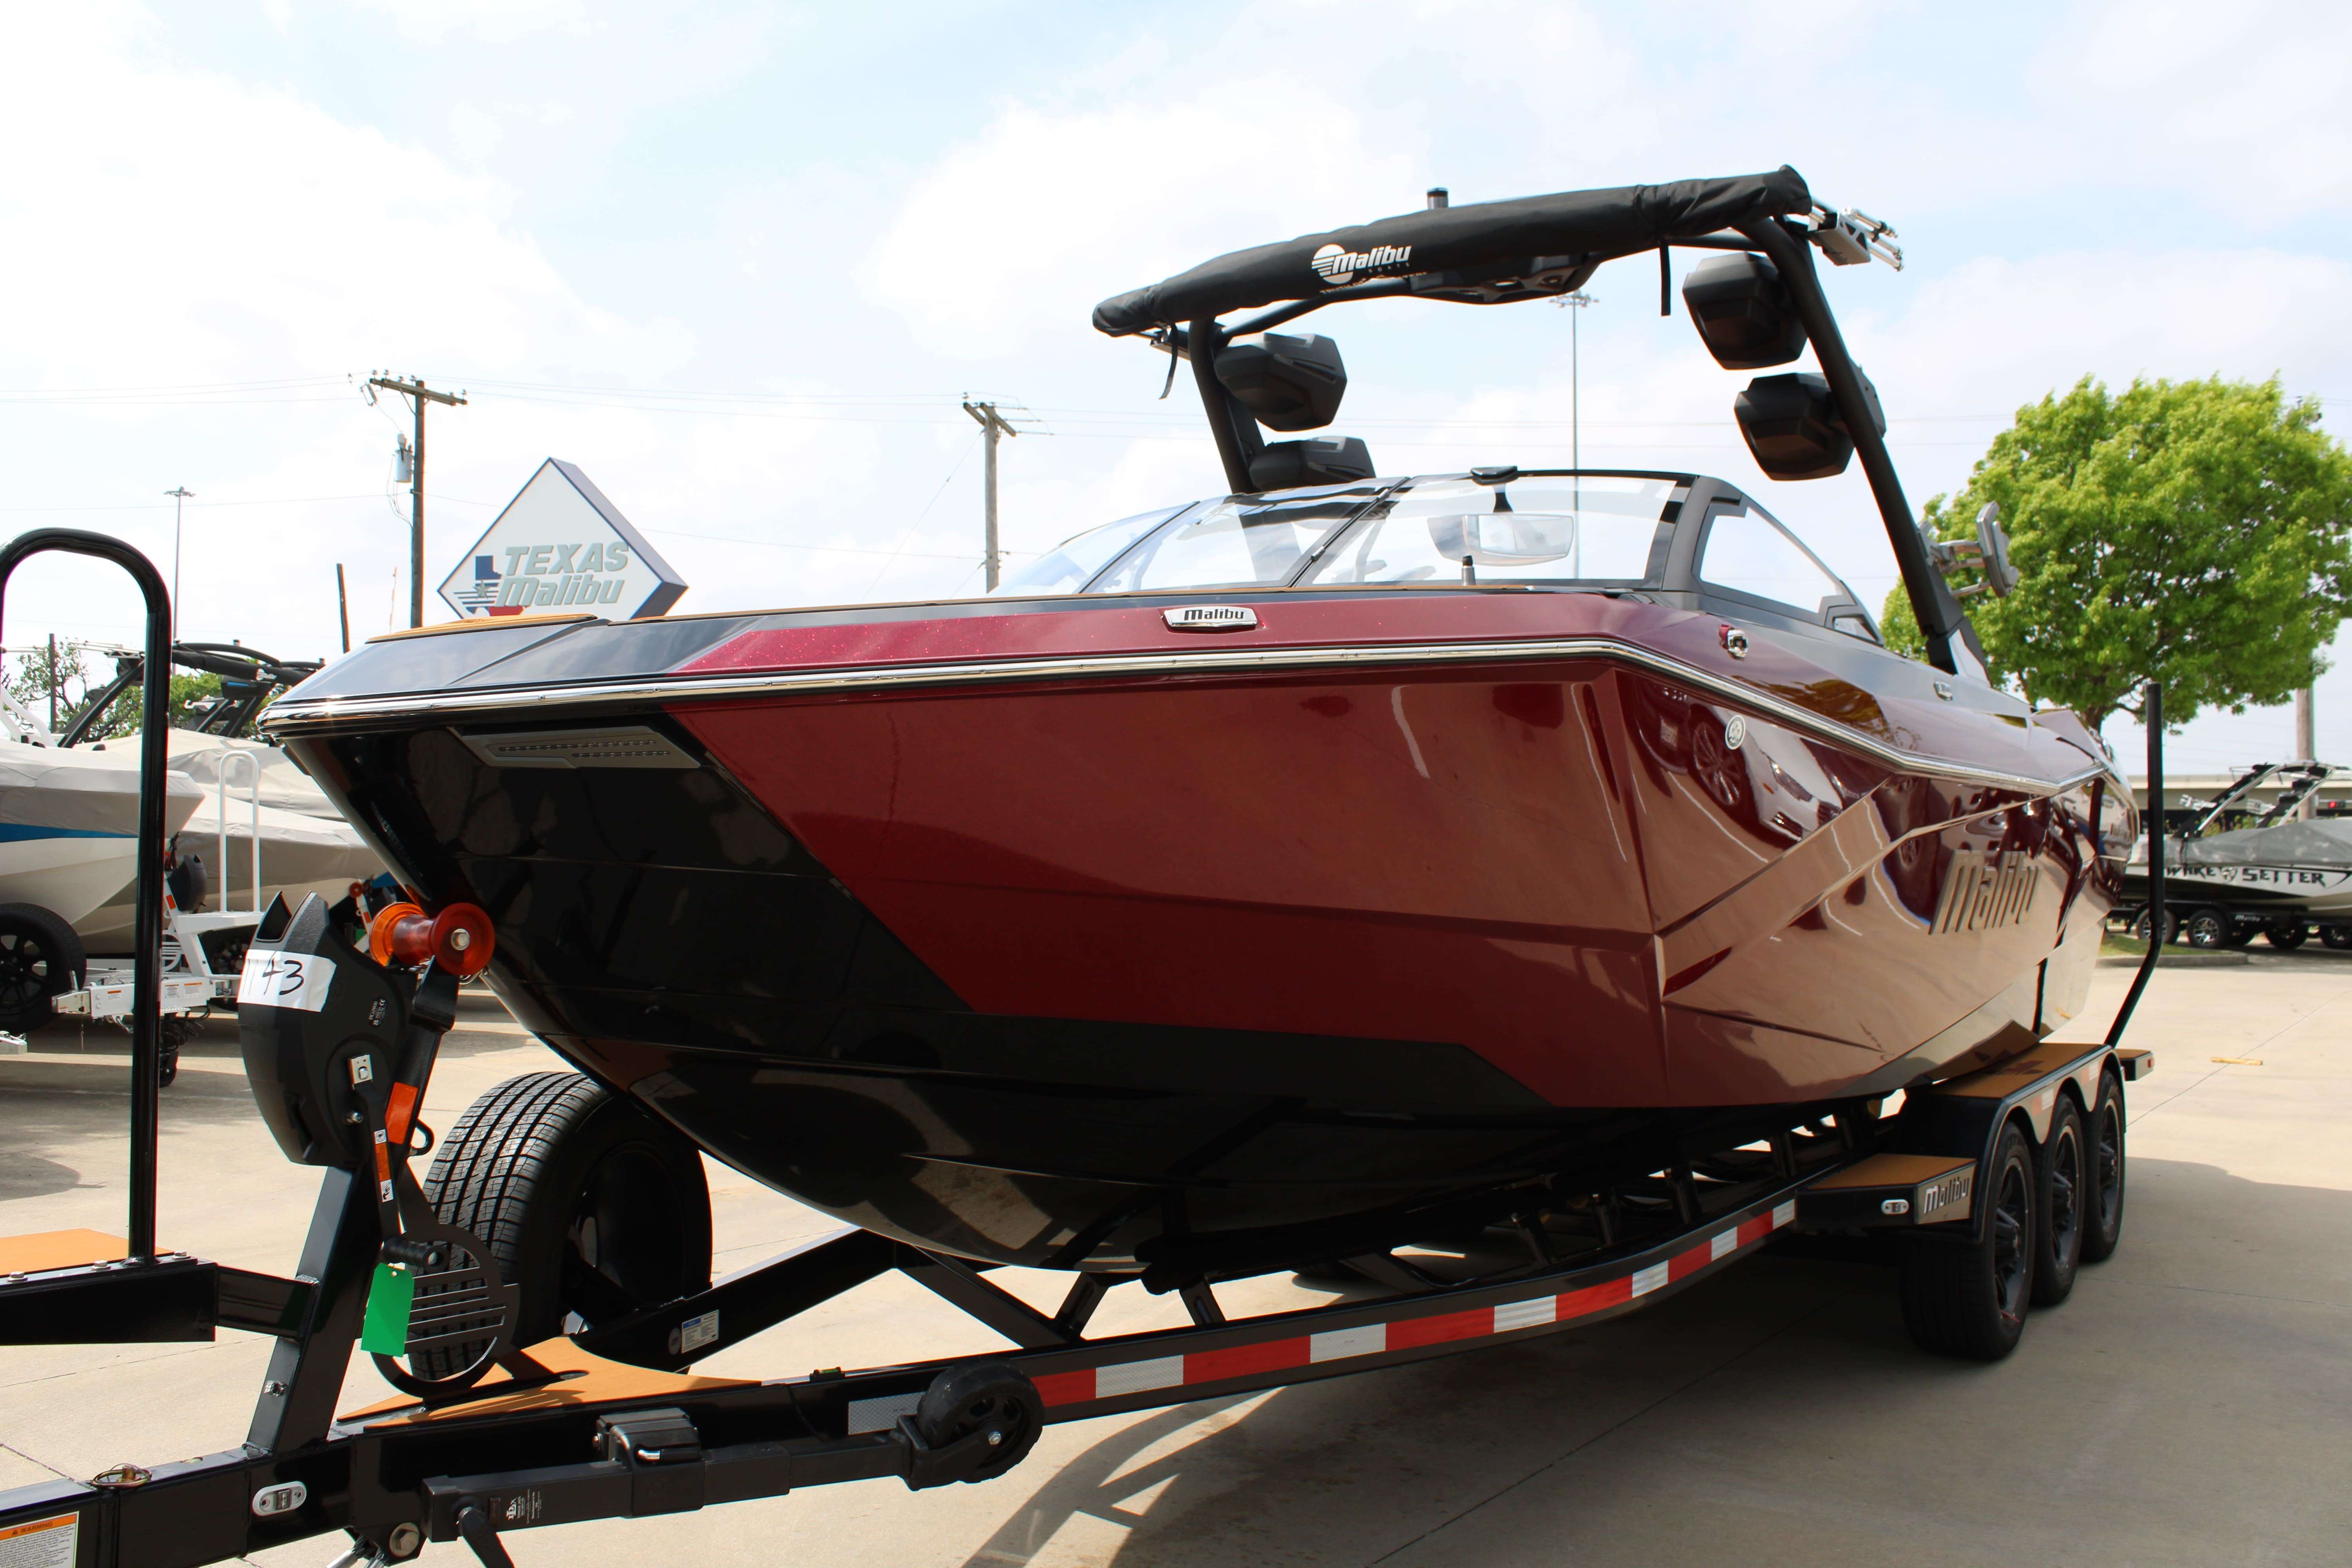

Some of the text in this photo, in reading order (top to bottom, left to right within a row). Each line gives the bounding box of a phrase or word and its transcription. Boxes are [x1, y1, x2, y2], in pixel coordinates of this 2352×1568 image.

[1332, 244, 1412, 274] Malibu
[505, 541, 629, 576] TEXAS
[494, 574, 626, 607] Malibu
[1183, 608, 1244, 621] Malibu
[1928, 849, 2040, 935] Malibu
[2242, 867, 2327, 888] SETTER
[1923, 1177, 1970, 1214] Malibu
[21, 1522, 53, 1533] WARNING
